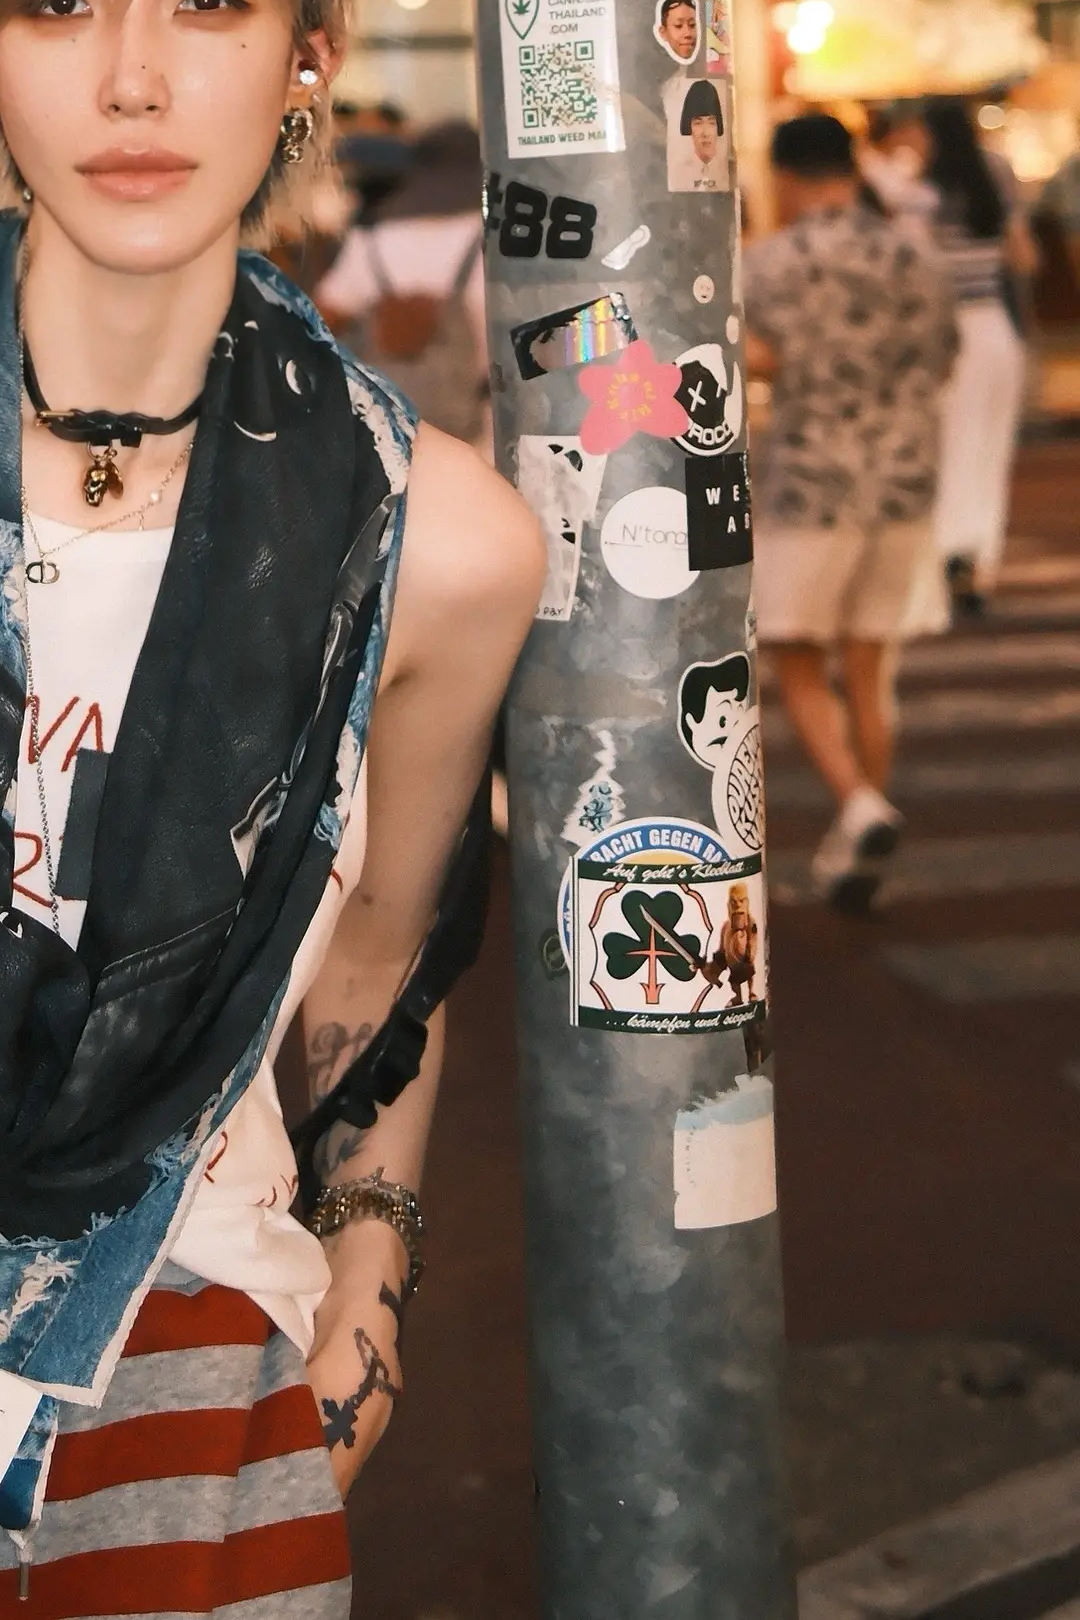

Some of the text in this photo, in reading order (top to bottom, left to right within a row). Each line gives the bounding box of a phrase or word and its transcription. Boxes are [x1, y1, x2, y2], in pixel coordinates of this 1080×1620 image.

[548, 7, 607, 20] THAILAND
[549, 23, 579, 35] .COM
[518, 135, 556, 145] THAILAND
[558, 132, 585, 142] WEED
[648, 828, 704, 852] GEGEN
[603, 863, 638, 882] Auf
[694, 1014, 721, 1027] und
[722, 1005, 758, 1026] siegen!
